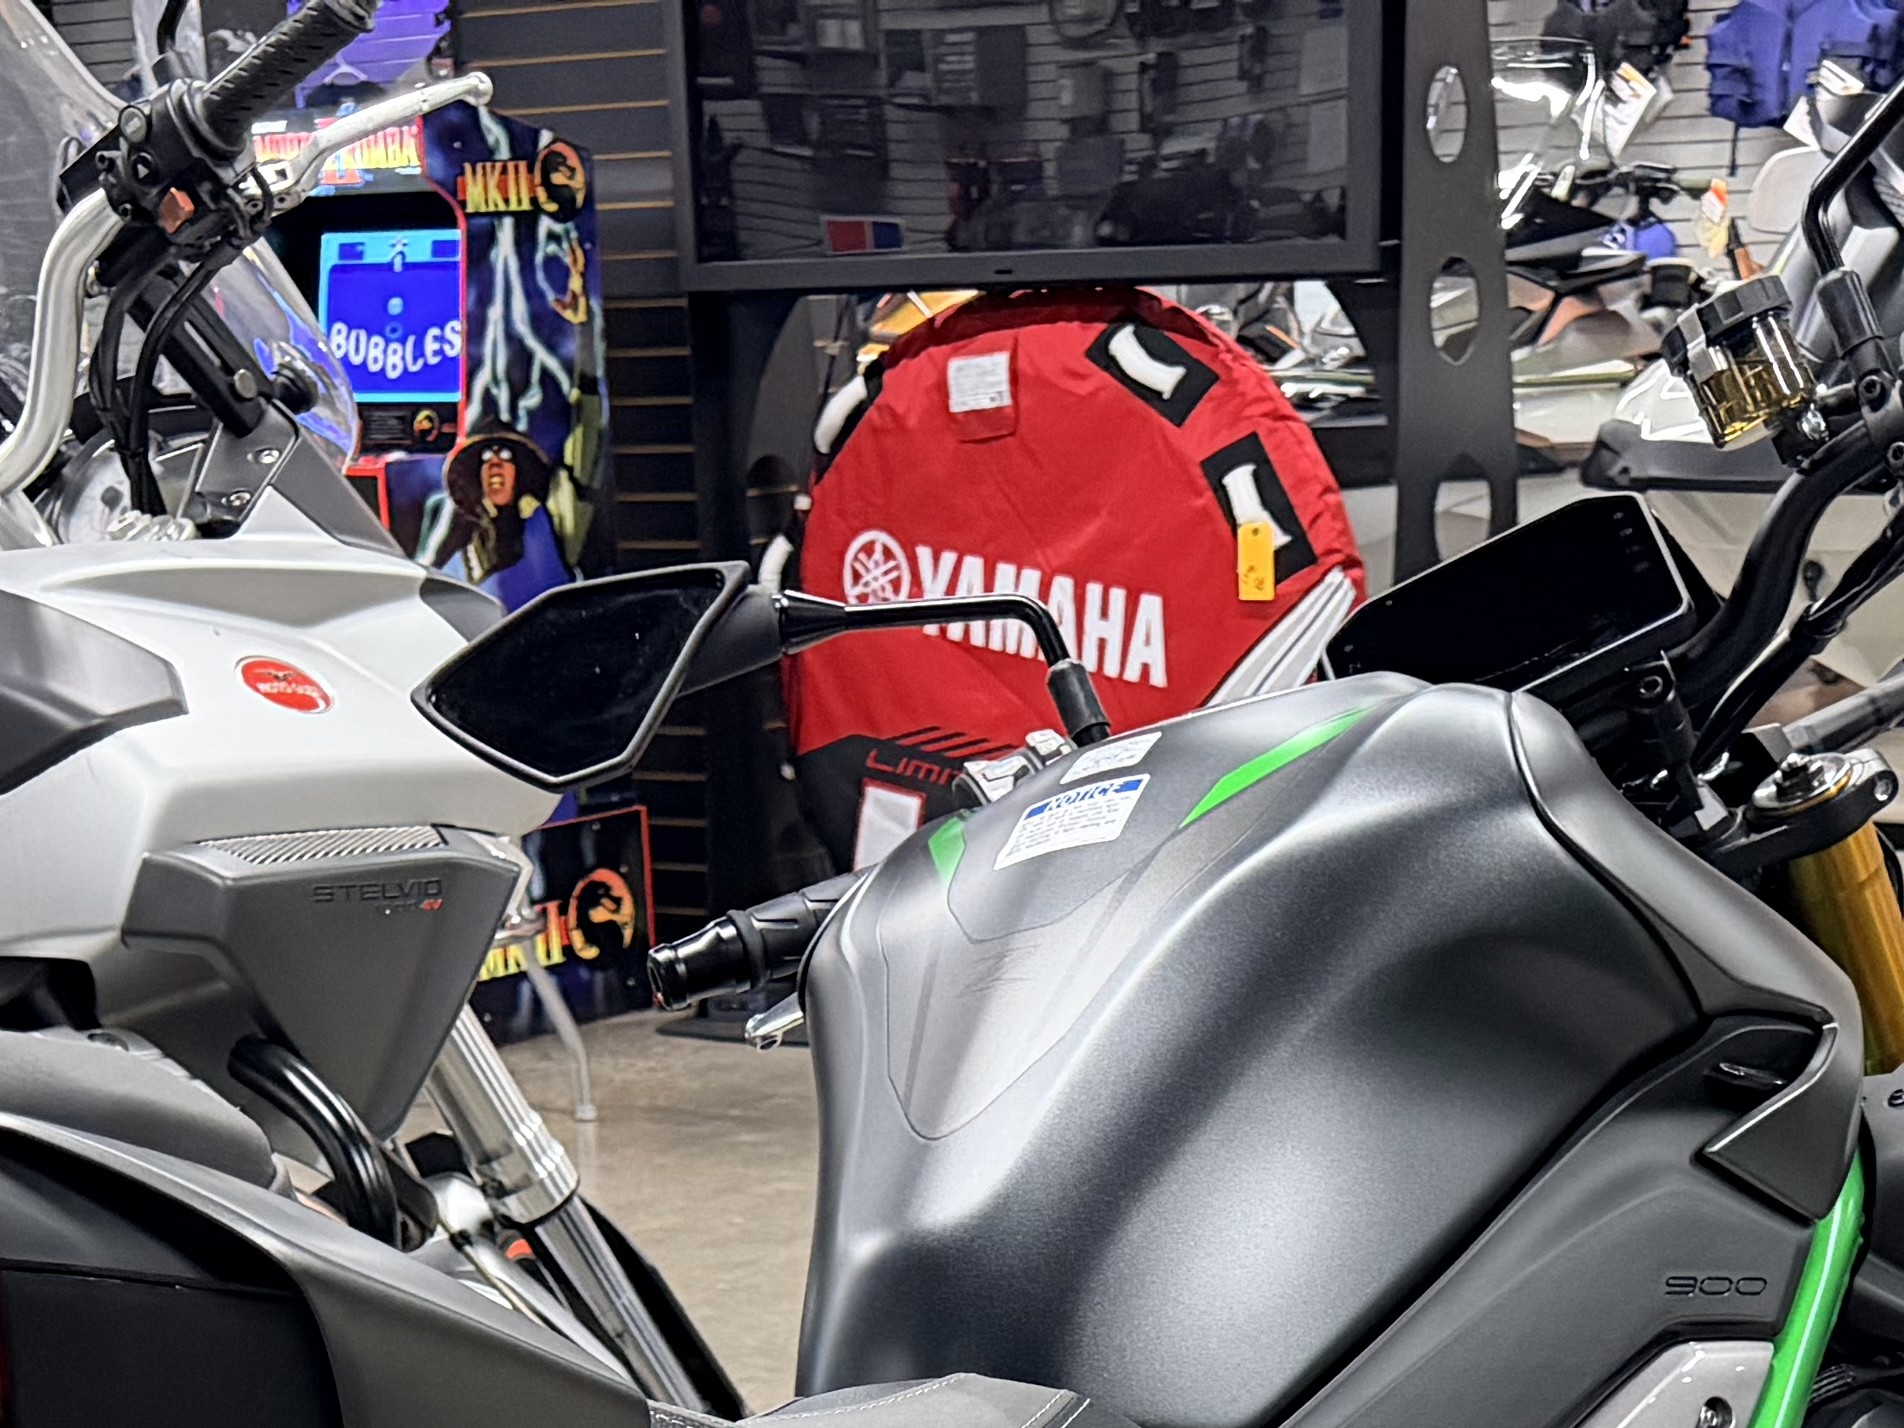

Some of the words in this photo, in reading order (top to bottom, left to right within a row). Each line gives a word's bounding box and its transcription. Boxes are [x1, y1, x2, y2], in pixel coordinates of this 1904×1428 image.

[328, 320, 462, 379] BUBBLES
[914, 544, 1168, 688] YAMAHA
[312, 879, 442, 902] STELVIO
[1664, 1275, 1768, 1296] 900
